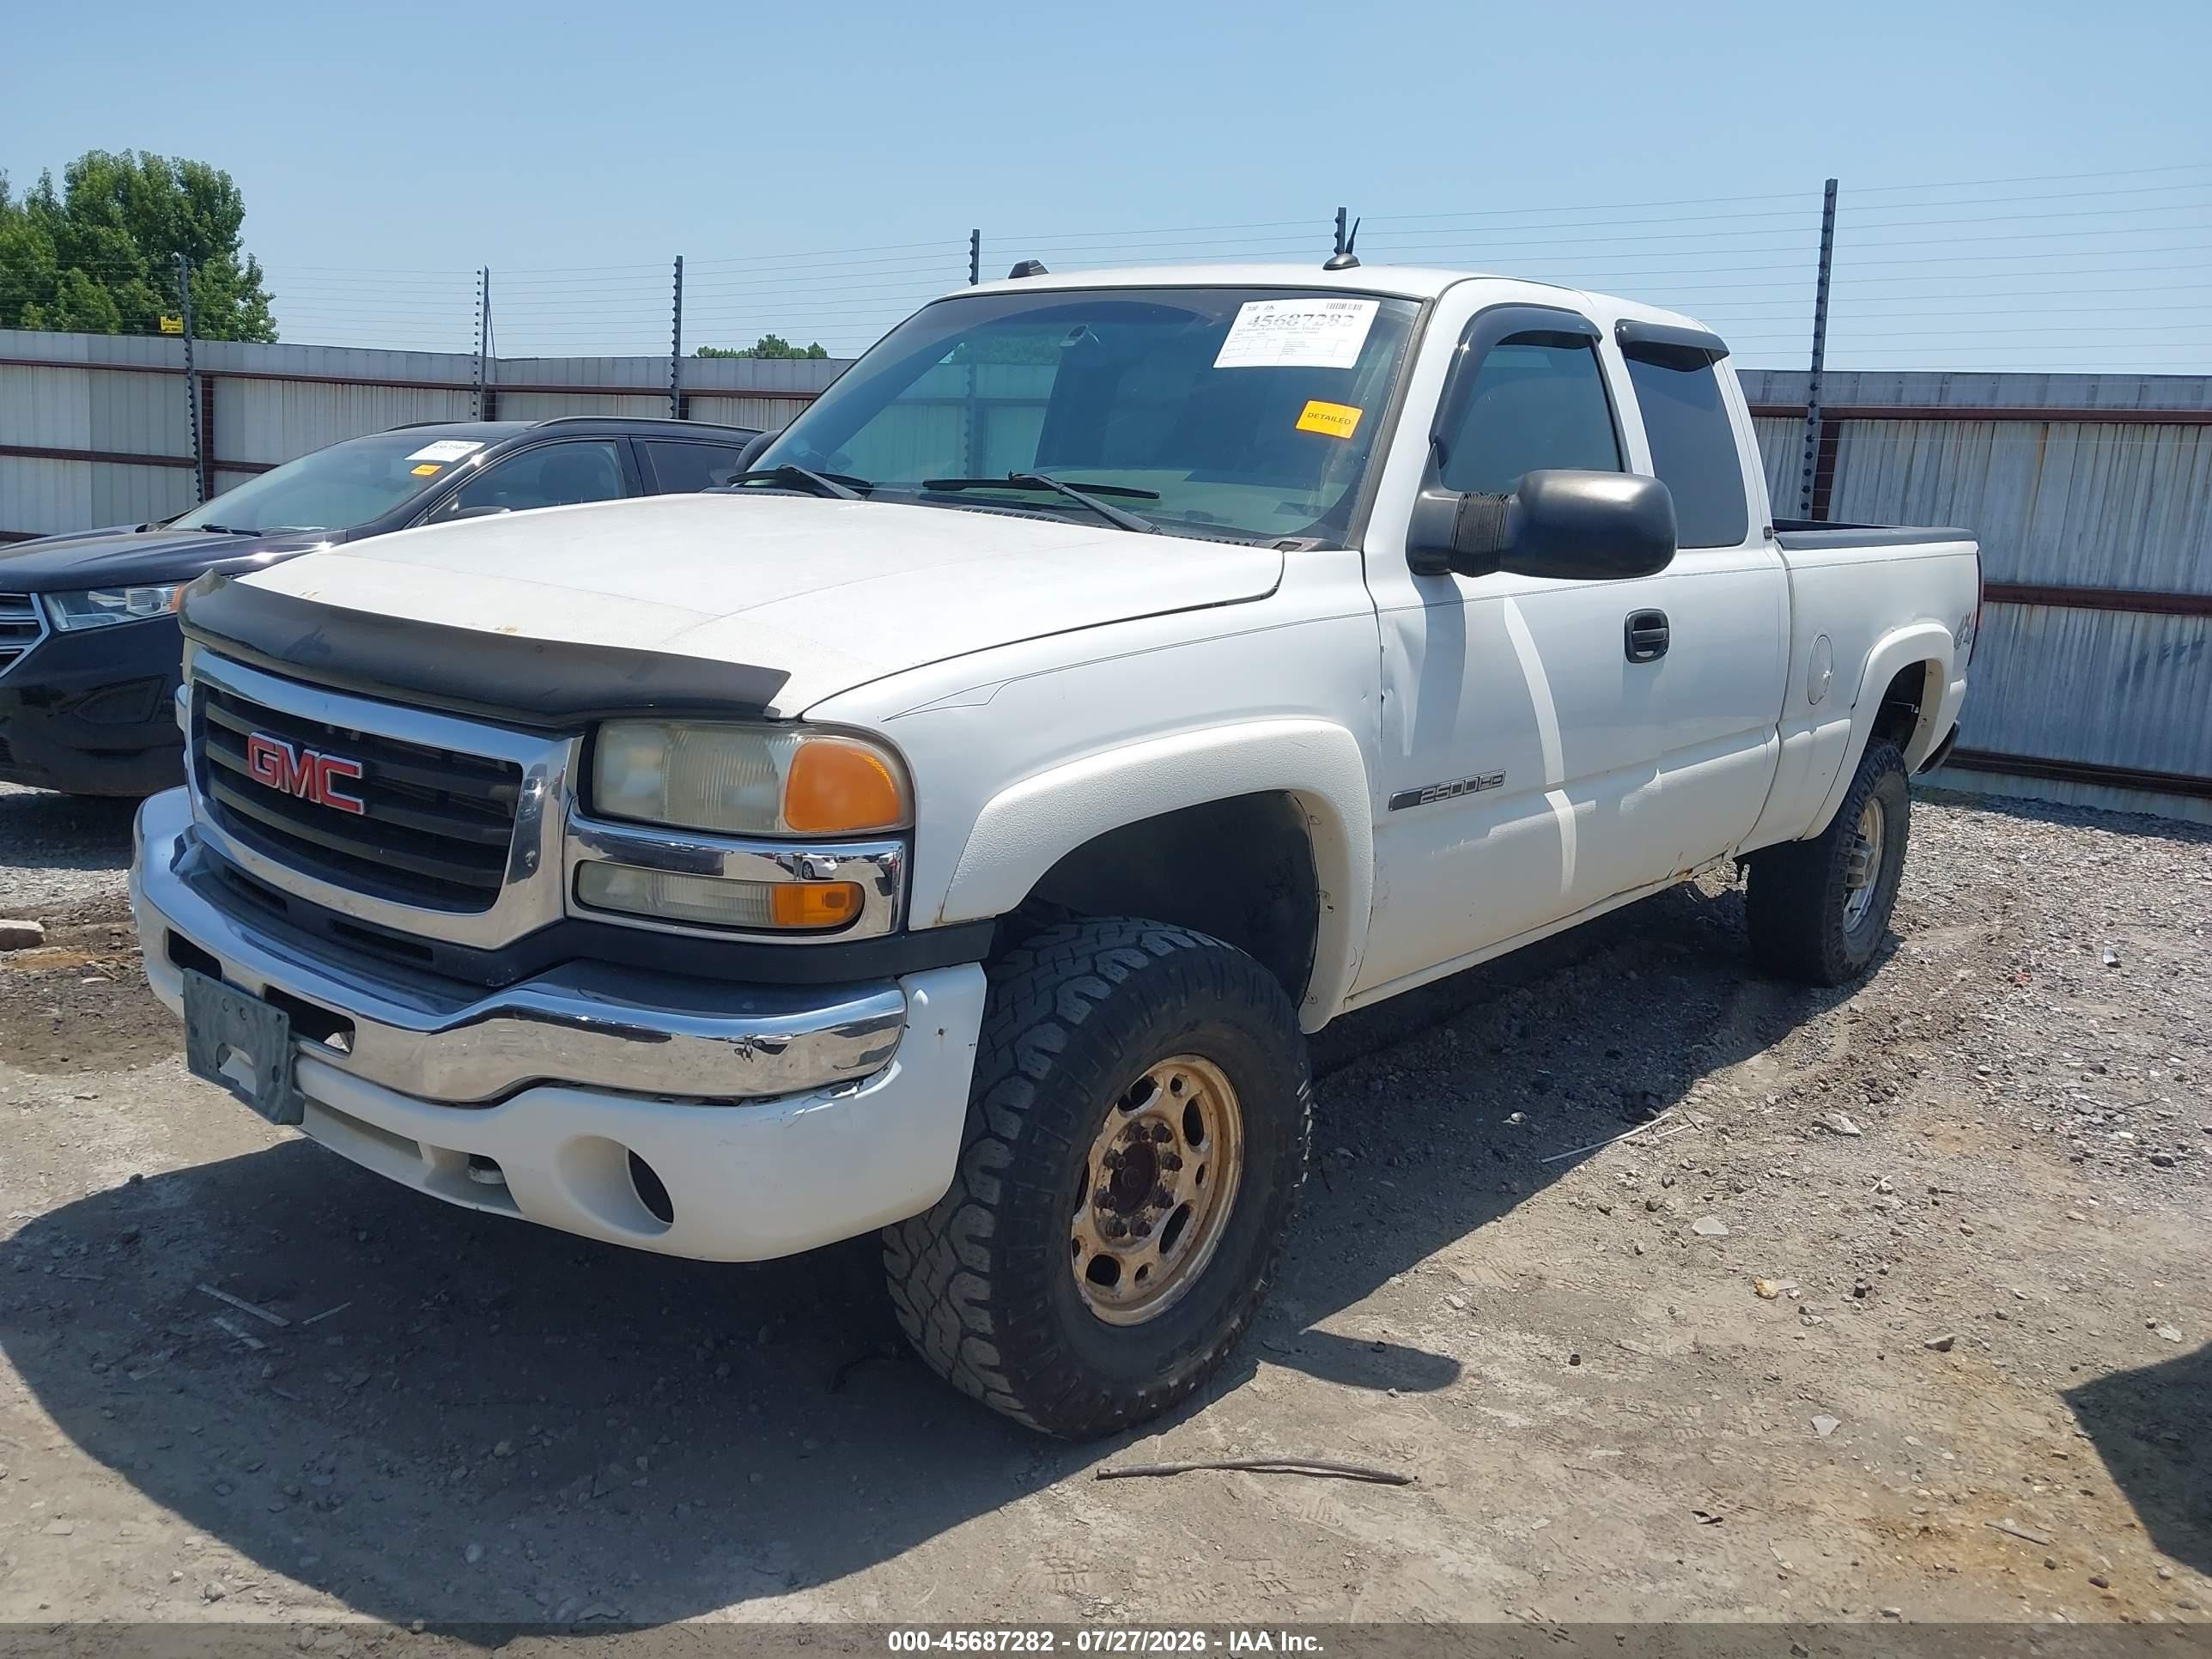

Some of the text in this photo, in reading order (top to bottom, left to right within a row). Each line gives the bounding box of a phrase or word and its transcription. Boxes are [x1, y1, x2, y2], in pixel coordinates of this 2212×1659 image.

[1247, 314, 1354, 328] 45687282
[1307, 412, 1352, 426] DETAILED
[248, 732, 364, 815] GMC
